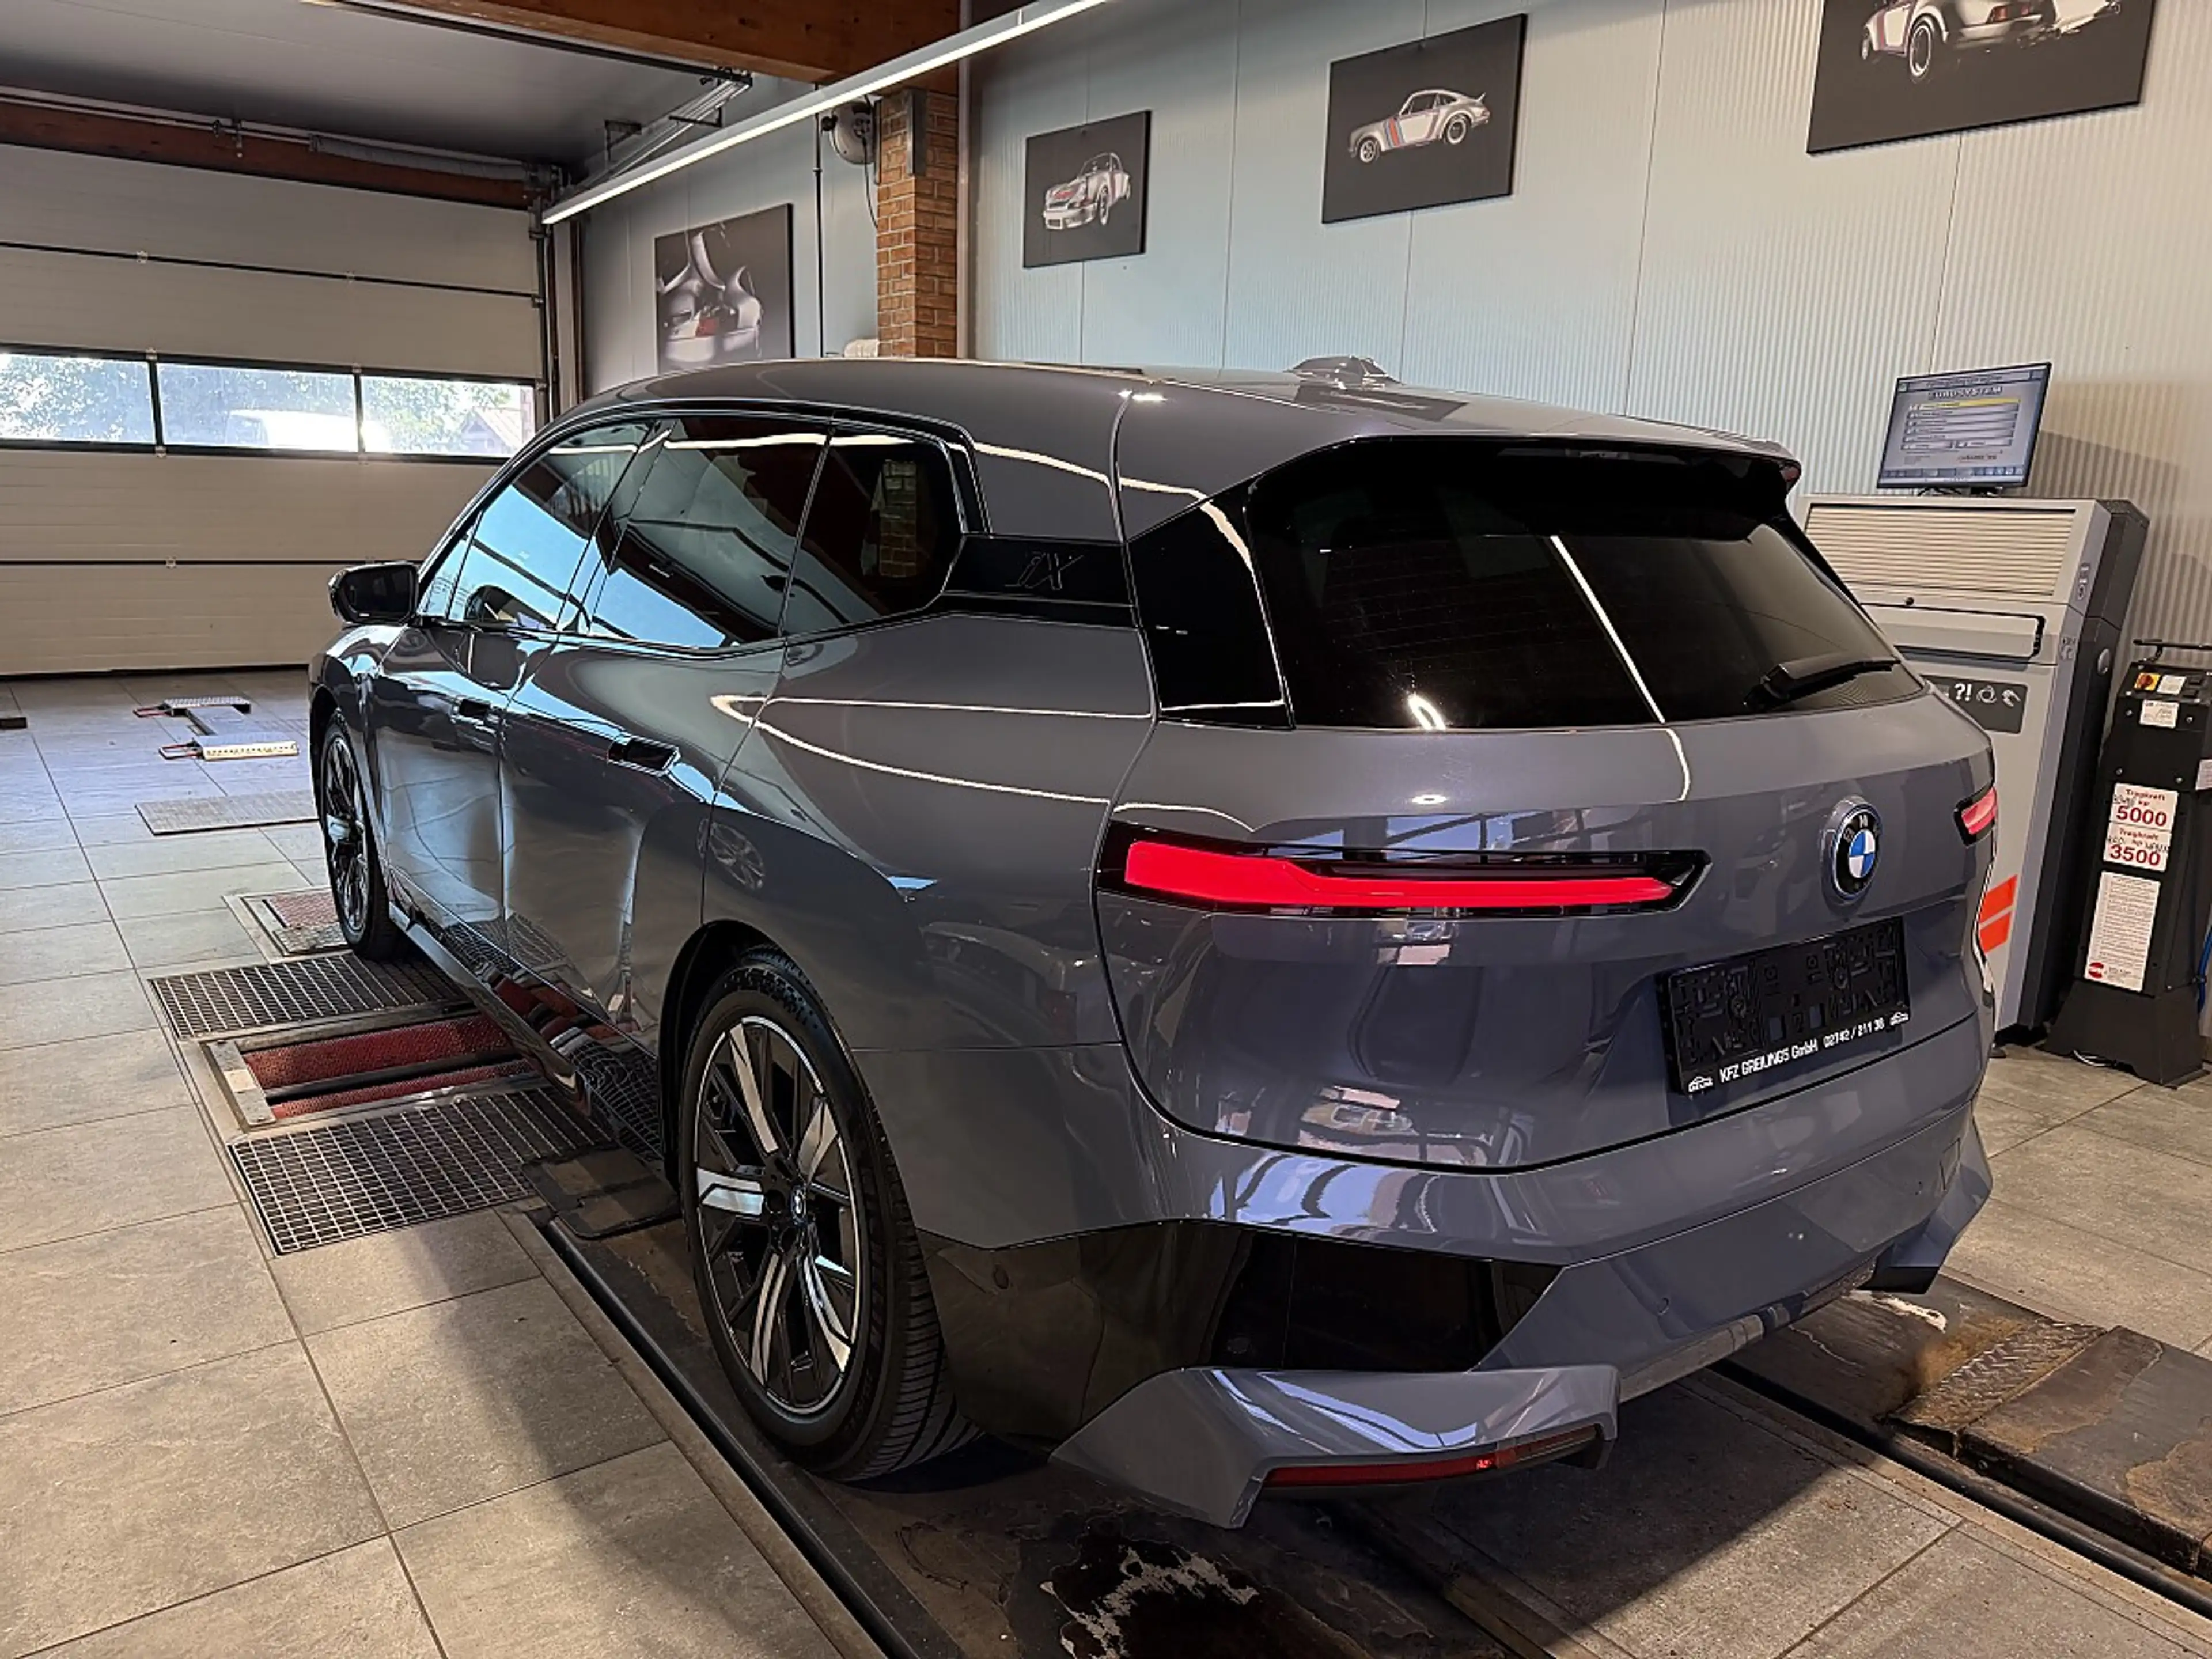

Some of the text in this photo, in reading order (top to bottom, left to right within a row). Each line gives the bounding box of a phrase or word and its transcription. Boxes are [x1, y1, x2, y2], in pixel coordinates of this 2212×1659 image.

[2116, 805, 2167, 827] 5000
[2110, 844, 2161, 866] 3500
[1719, 1063, 1741, 1083] KFZ
[1791, 1037, 1819, 1059] GmbH
